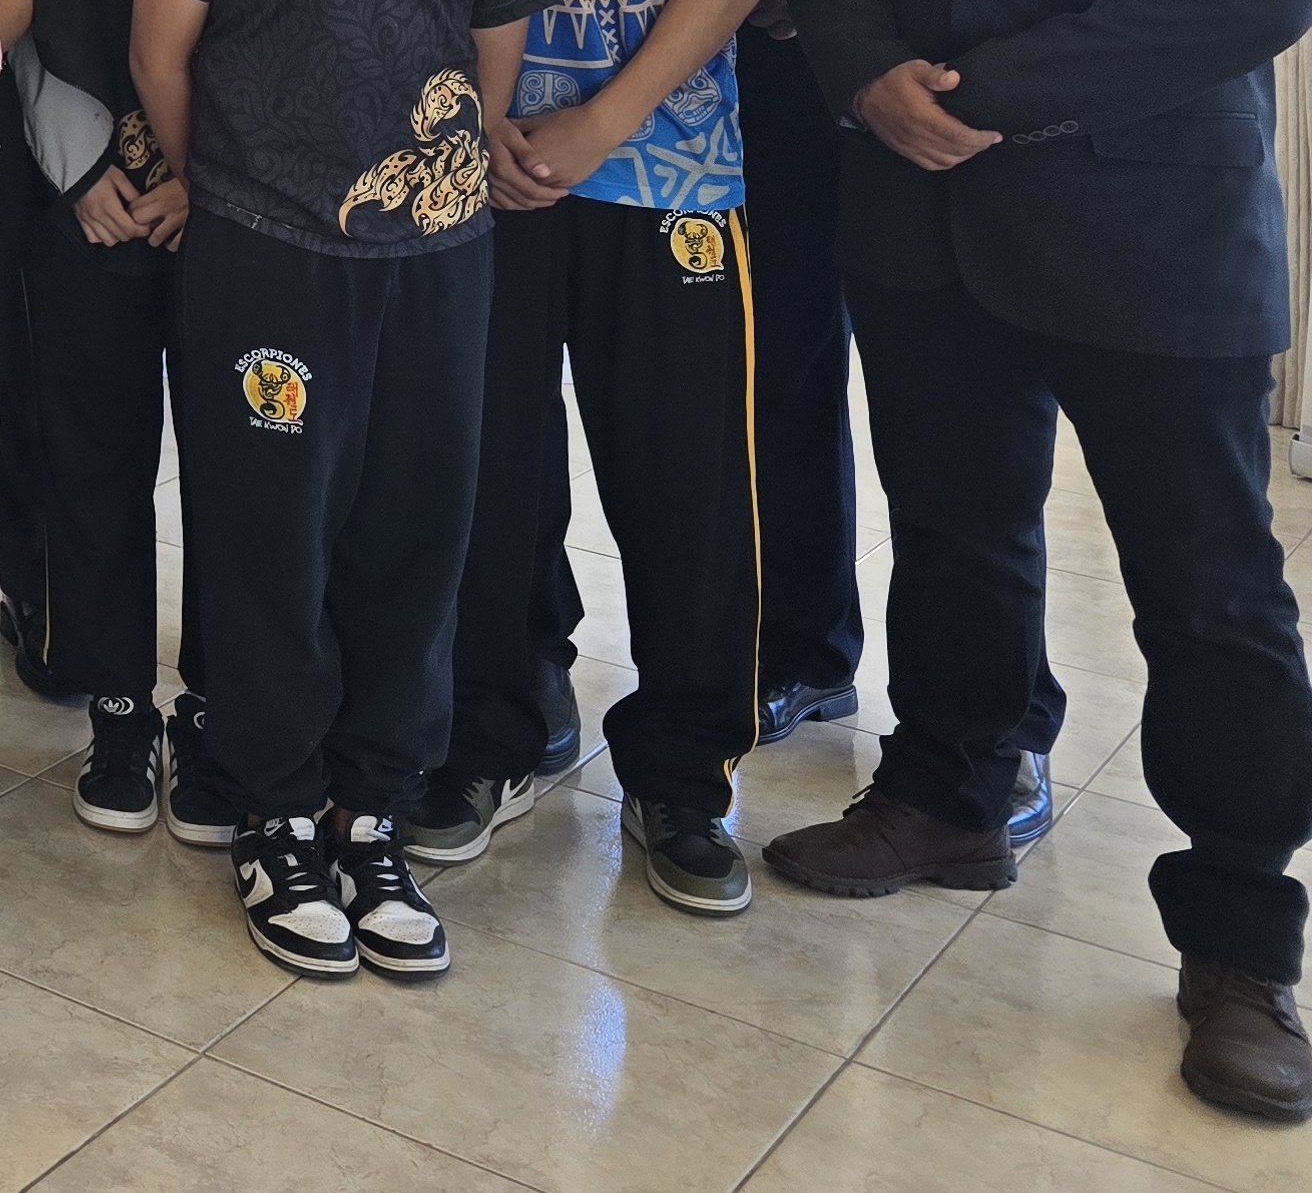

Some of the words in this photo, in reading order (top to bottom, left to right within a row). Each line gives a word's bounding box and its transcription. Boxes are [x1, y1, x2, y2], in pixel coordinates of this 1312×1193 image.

[234, 347, 313, 381] ESCORPIONES
[249, 416, 263, 427] TAE
[264, 422, 289, 433] KWON
[290, 424, 303, 434] DO
